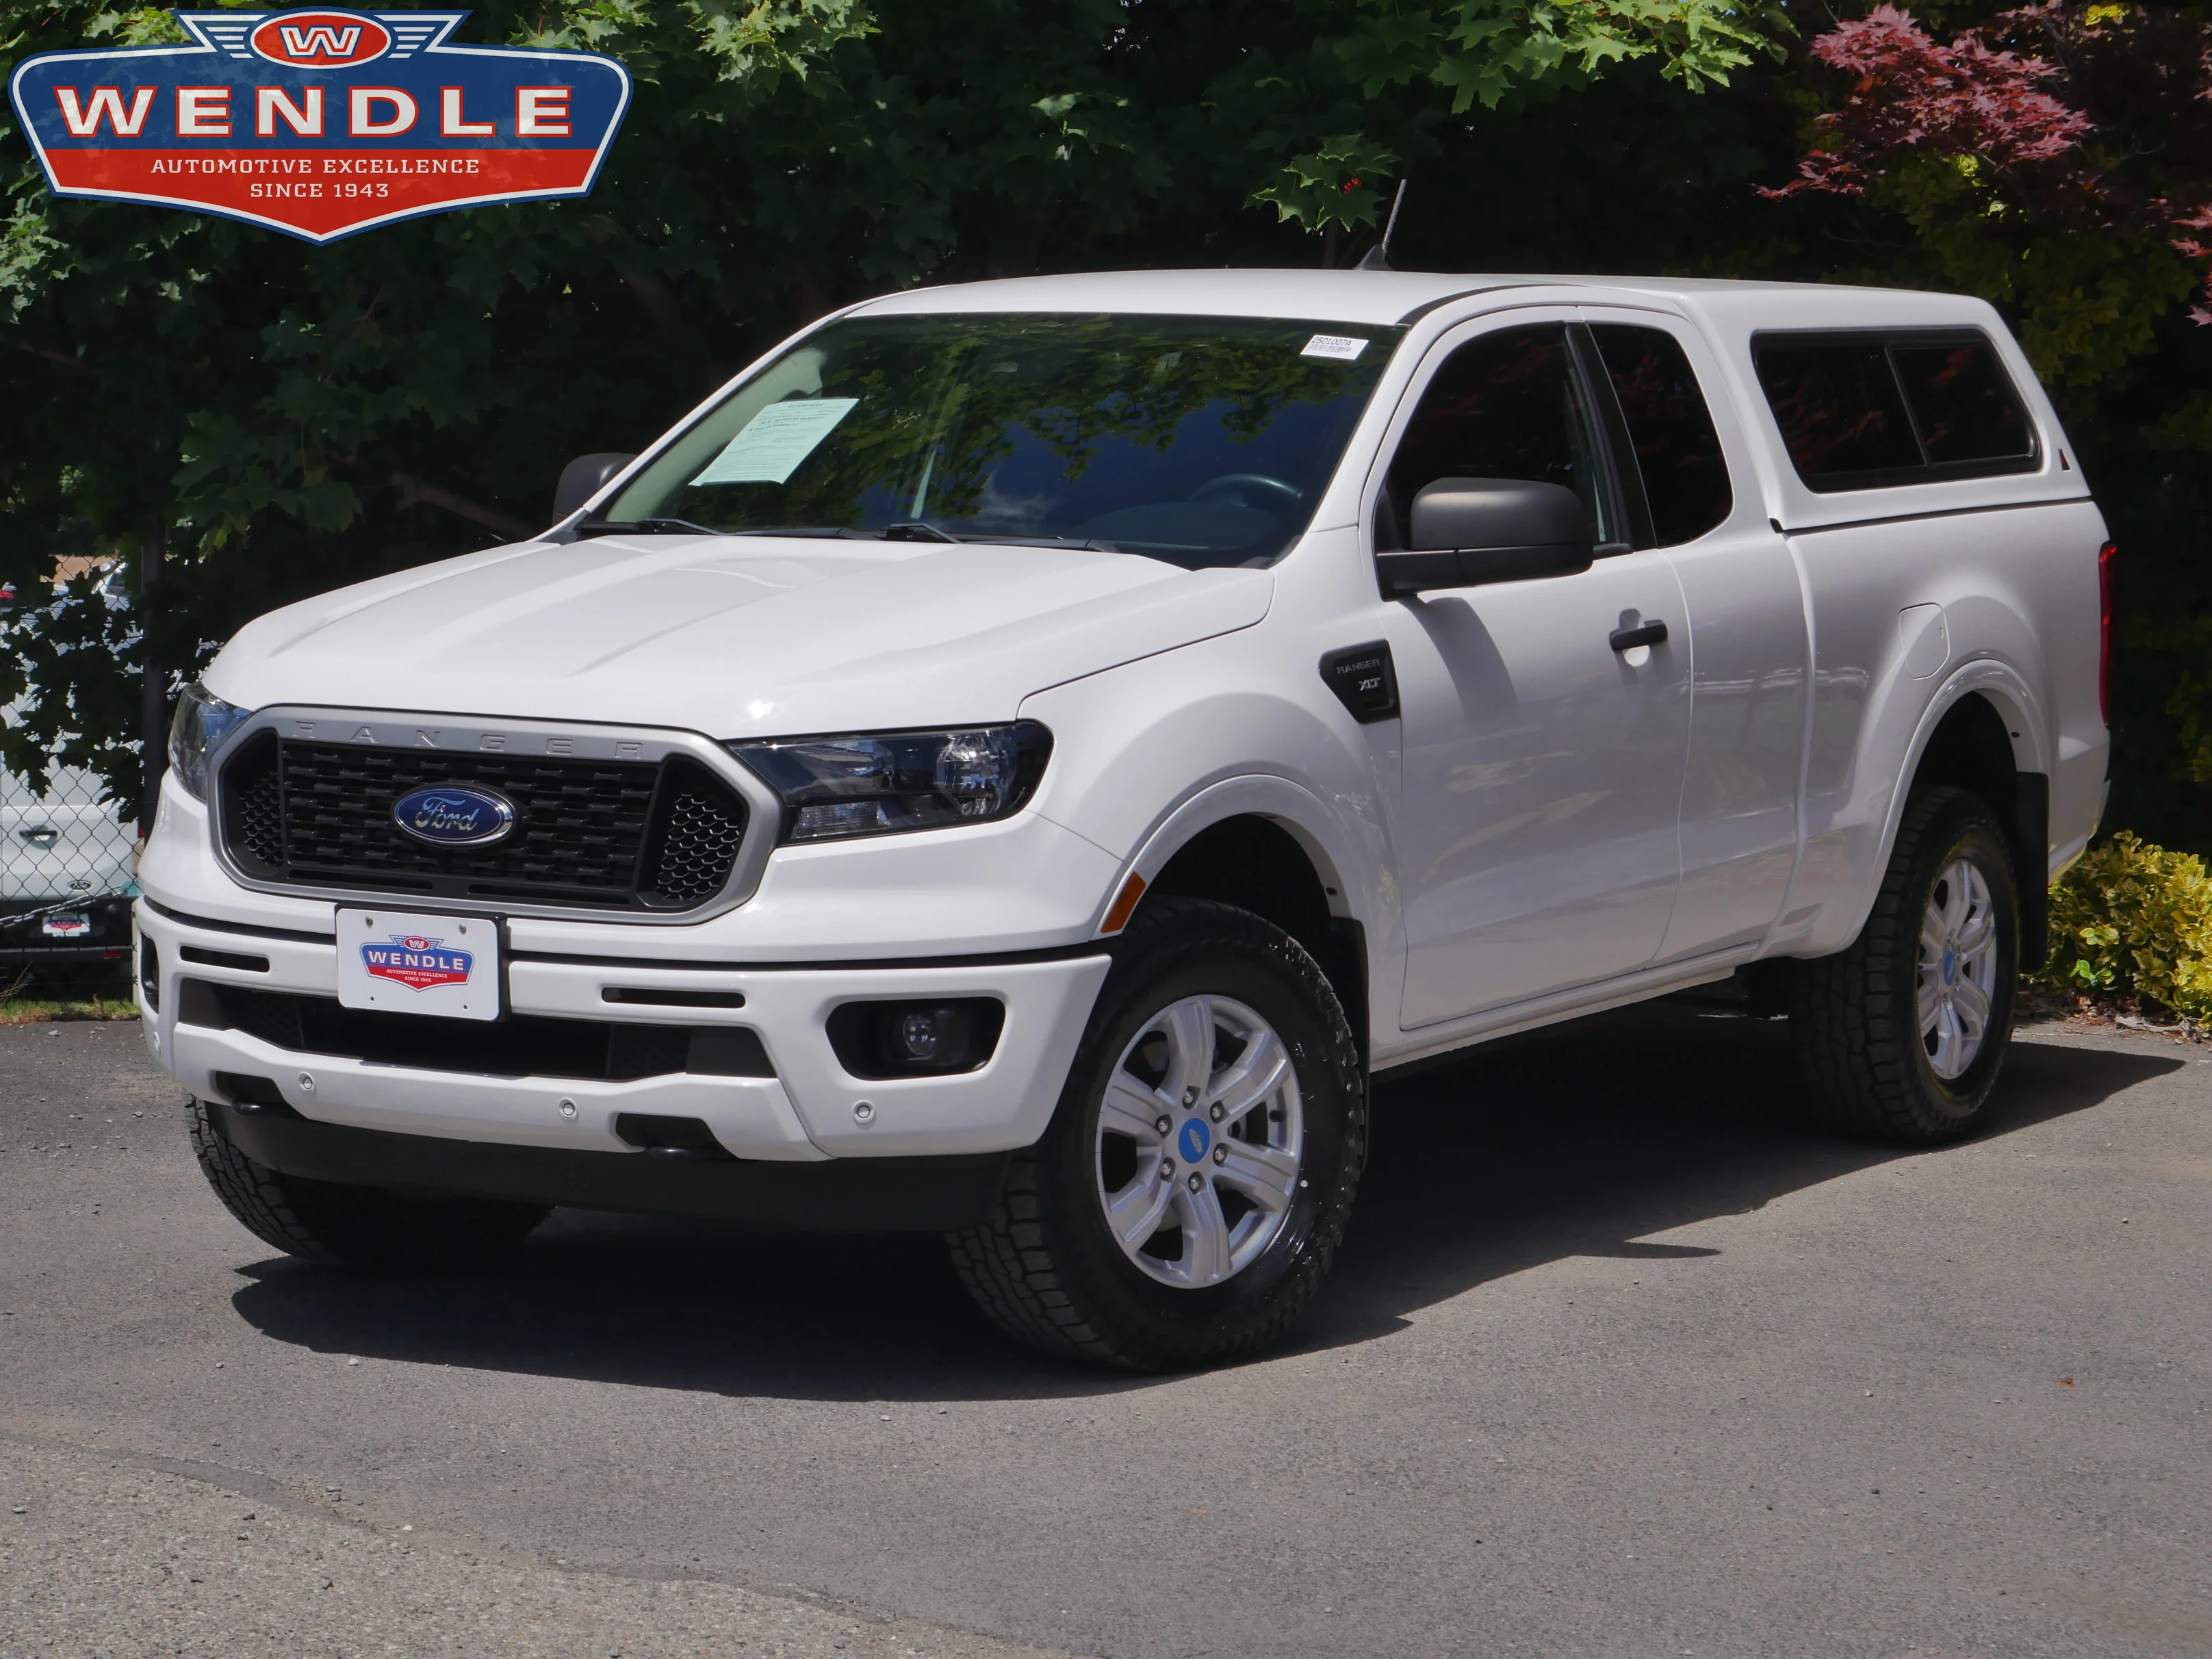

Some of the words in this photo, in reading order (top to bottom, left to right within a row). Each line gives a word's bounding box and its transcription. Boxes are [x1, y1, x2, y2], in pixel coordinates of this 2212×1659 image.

[1337, 658, 1380, 674] RANGER
[1358, 677, 1381, 691] XLT
[292, 720, 644, 759] RANGER
[413, 795, 480, 834] Ford
[409, 940, 425, 949] W
[368, 951, 464, 970] WENDLE
